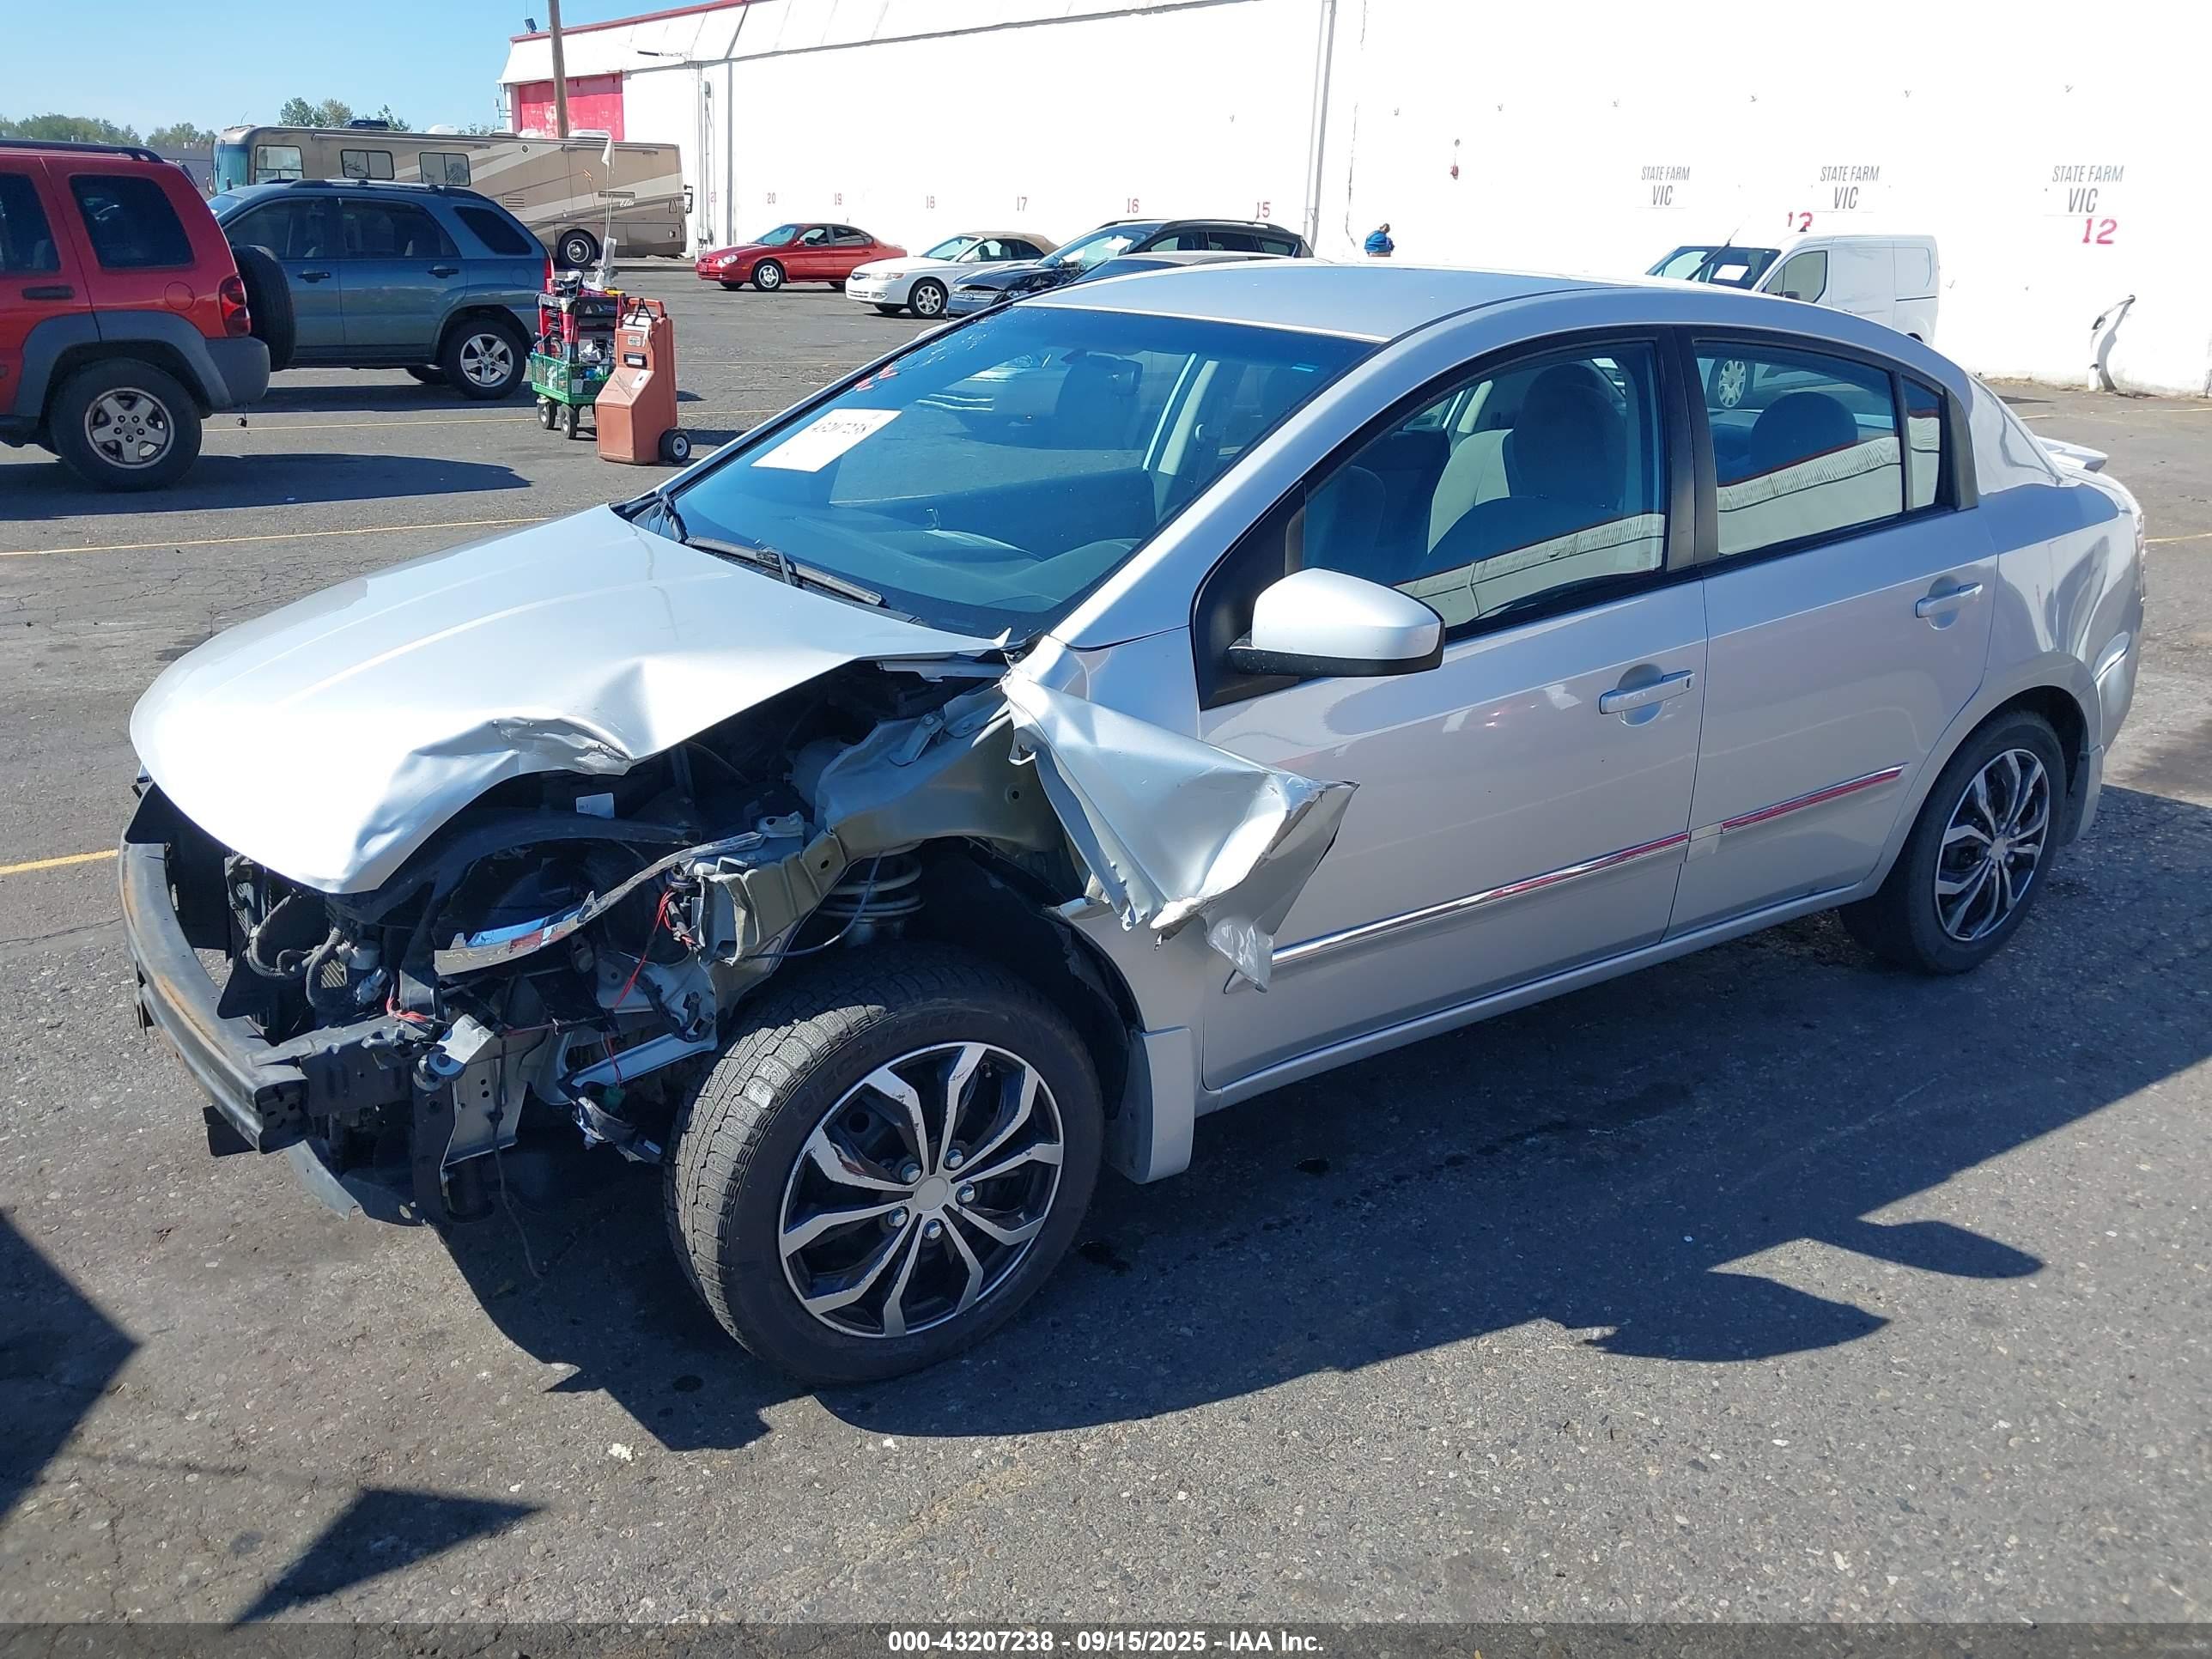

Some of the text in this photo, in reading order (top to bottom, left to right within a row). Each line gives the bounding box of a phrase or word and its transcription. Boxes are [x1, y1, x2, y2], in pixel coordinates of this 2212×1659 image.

[1641, 166, 1691, 180] STATE FARM
[1820, 165, 1880, 182] STATE FARM
[2051, 165, 2124, 183] STATE FARM
[767, 191, 776, 204] 20
[834, 192, 842, 206] 19
[926, 195, 935, 210] 18
[1016, 196, 1028, 212] 17
[1652, 185, 1674, 206] VIC
[1833, 185, 1859, 210] VIC
[2068, 187, 2099, 214] VIC
[1126, 198, 1139, 214] 16
[1255, 201, 1272, 219] 15
[2082, 218, 2118, 245] 12
